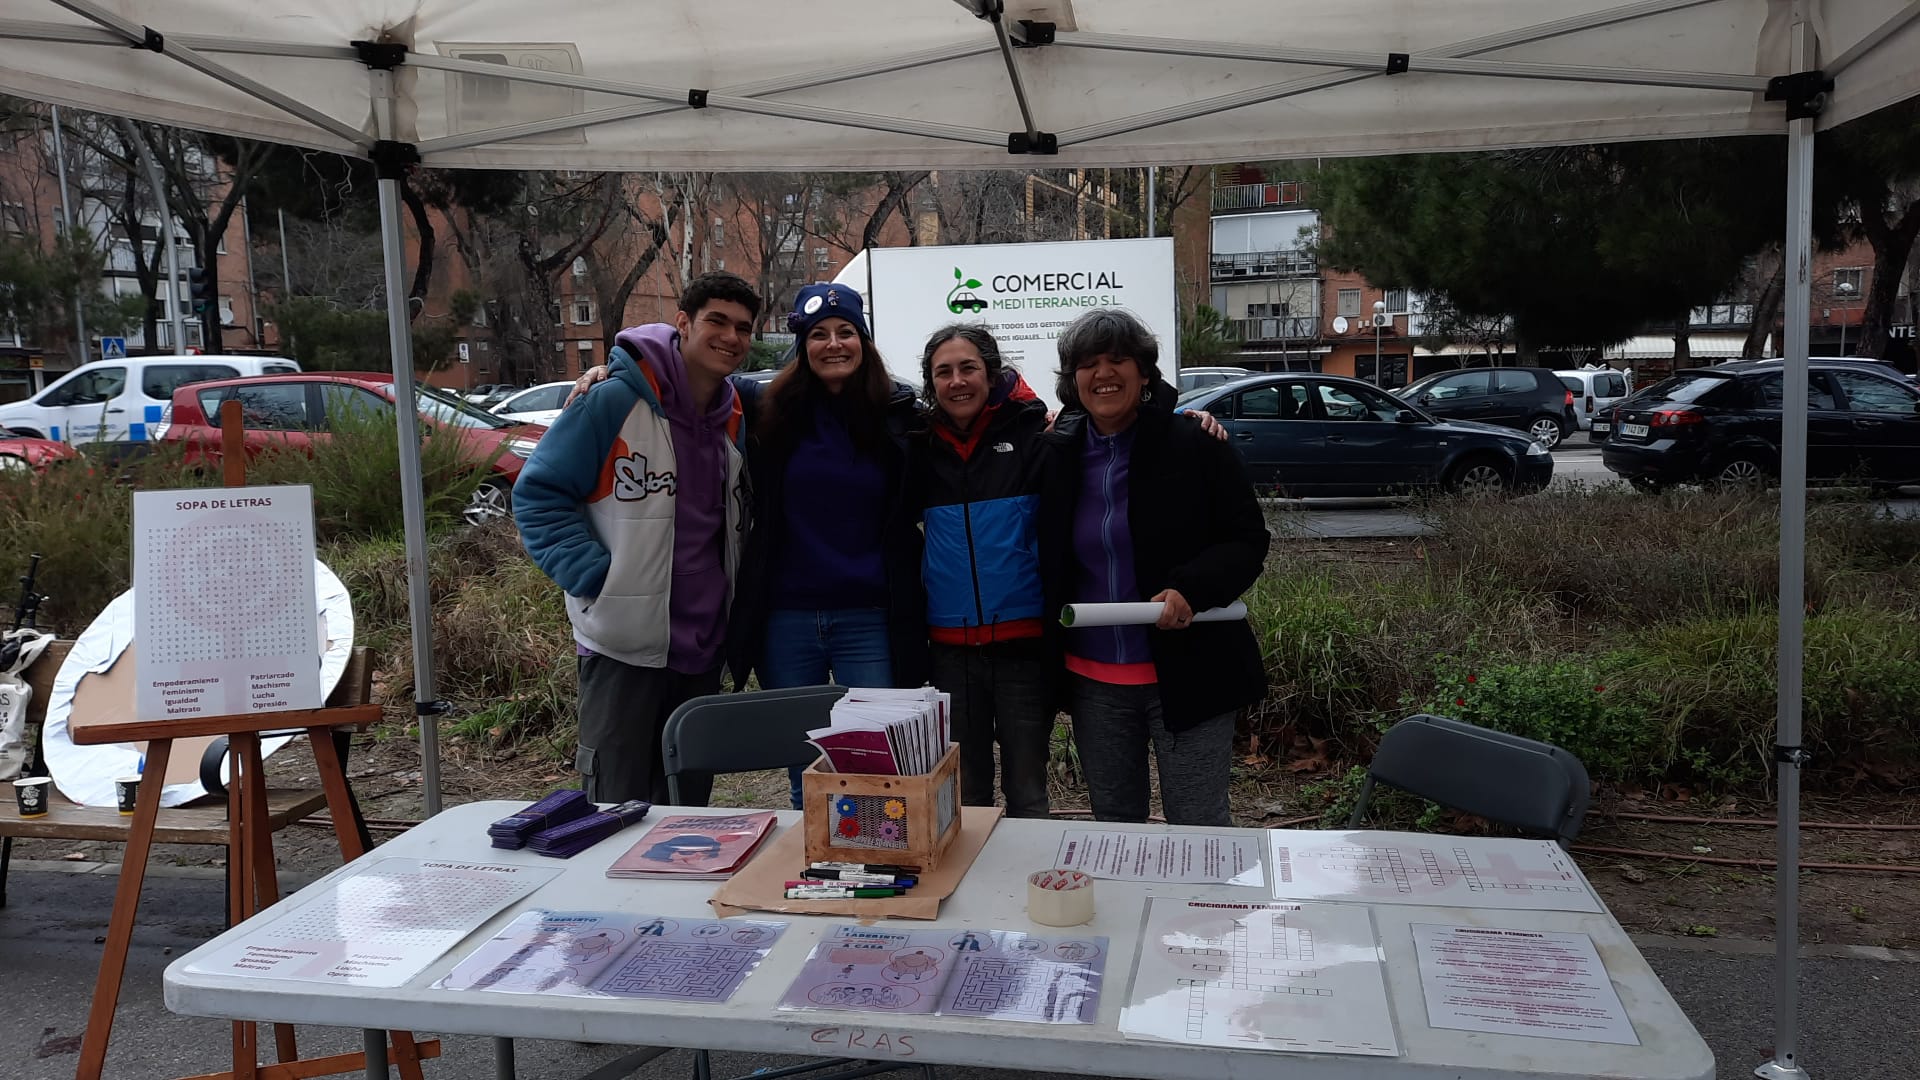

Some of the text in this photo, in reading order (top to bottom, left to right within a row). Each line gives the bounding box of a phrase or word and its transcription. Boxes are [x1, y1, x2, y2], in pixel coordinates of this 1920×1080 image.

[993, 272, 1123, 293] COMERCIAL
[992, 296, 1097, 310] MEDITERRANEO
[176, 497, 272, 510] SOPA DE LETRAS
[250, 672, 295, 680] Patriarcado
[152, 678, 219, 688] Empoderamiento
[251, 682, 291, 690] Machismo
[162, 687, 205, 696] Feminismo
[252, 692, 275, 700] Lucha
[164, 697, 199, 706] Igualdad
[252, 700, 288, 709] Opresión
[167, 706, 201, 714] Maltrato
[1188, 901, 1249, 910] CRUCIGRAMA
